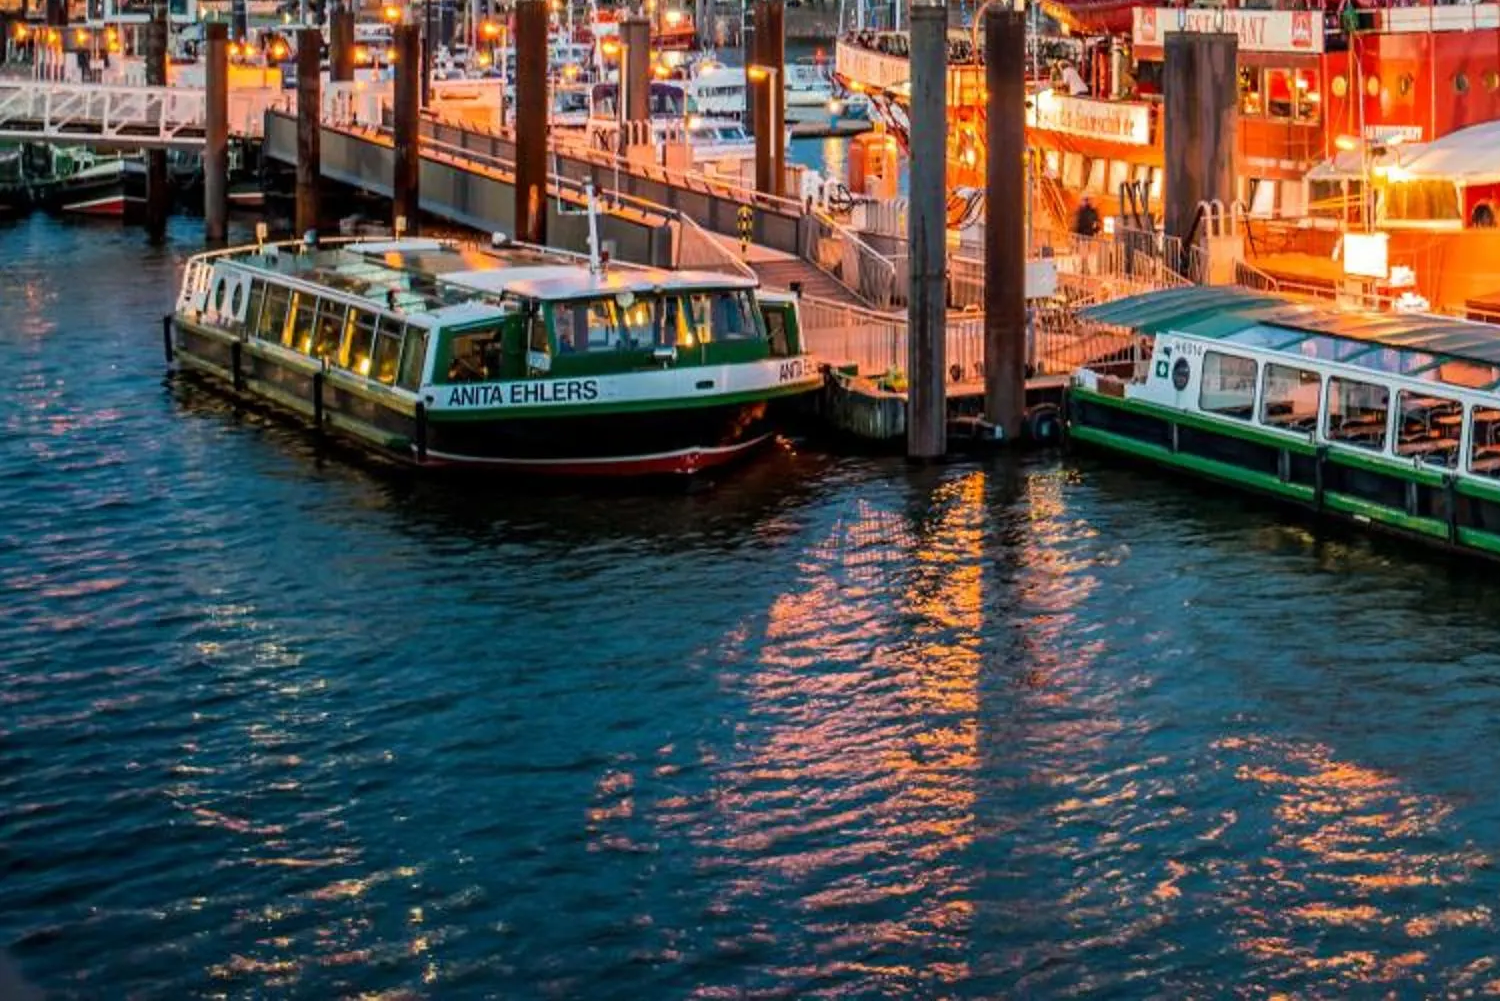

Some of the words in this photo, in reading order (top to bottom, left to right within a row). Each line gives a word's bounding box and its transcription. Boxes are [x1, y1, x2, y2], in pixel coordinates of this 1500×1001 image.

[1178, 11, 1268, 45] ESTRANT
[449, 385, 503, 407] ANITA
[509, 380, 599, 404] EHLERS
